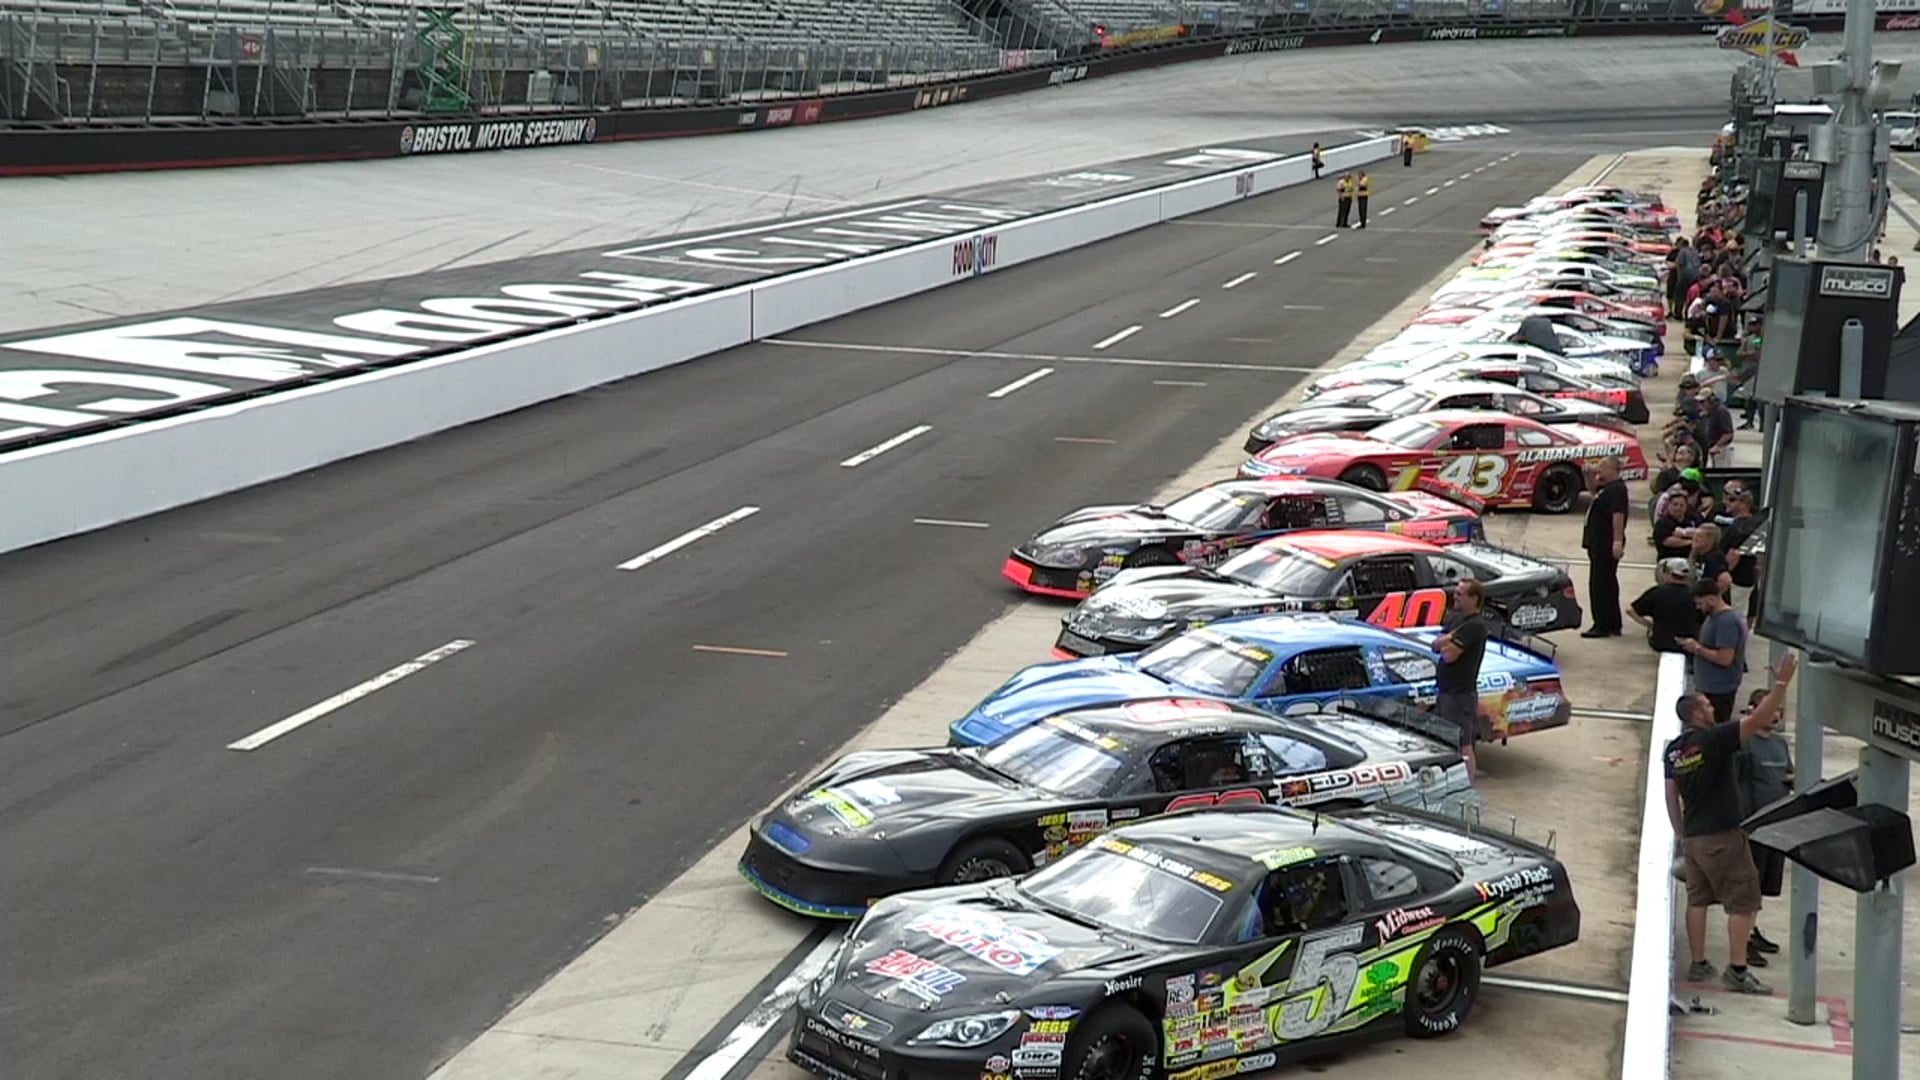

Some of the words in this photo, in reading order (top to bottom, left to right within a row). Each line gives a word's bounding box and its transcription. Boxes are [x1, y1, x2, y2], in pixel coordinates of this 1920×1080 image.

[1722, 32, 1802, 47] SUNCO
[412, 126, 472, 153] BRISTOL
[475, 122, 524, 148] MOTOR
[525, 119, 588, 145] SPEEDWAY
[952, 240, 973, 275] FOOD
[1824, 275, 1888, 293] musco
[1515, 448, 1583, 464] ALABAMA
[1438, 453, 1509, 498] 43
[1366, 588, 1447, 630] 40
[1309, 763, 1405, 792] EDCO
[1482, 873, 1522, 898] Crystal
[1376, 905, 1435, 949] Midwest
[913, 921, 1024, 968] AUTO
[1104, 975, 1143, 997] Hoosier
[1288, 922, 1366, 1041] 5
[1031, 1020, 1070, 1033] JEGS
